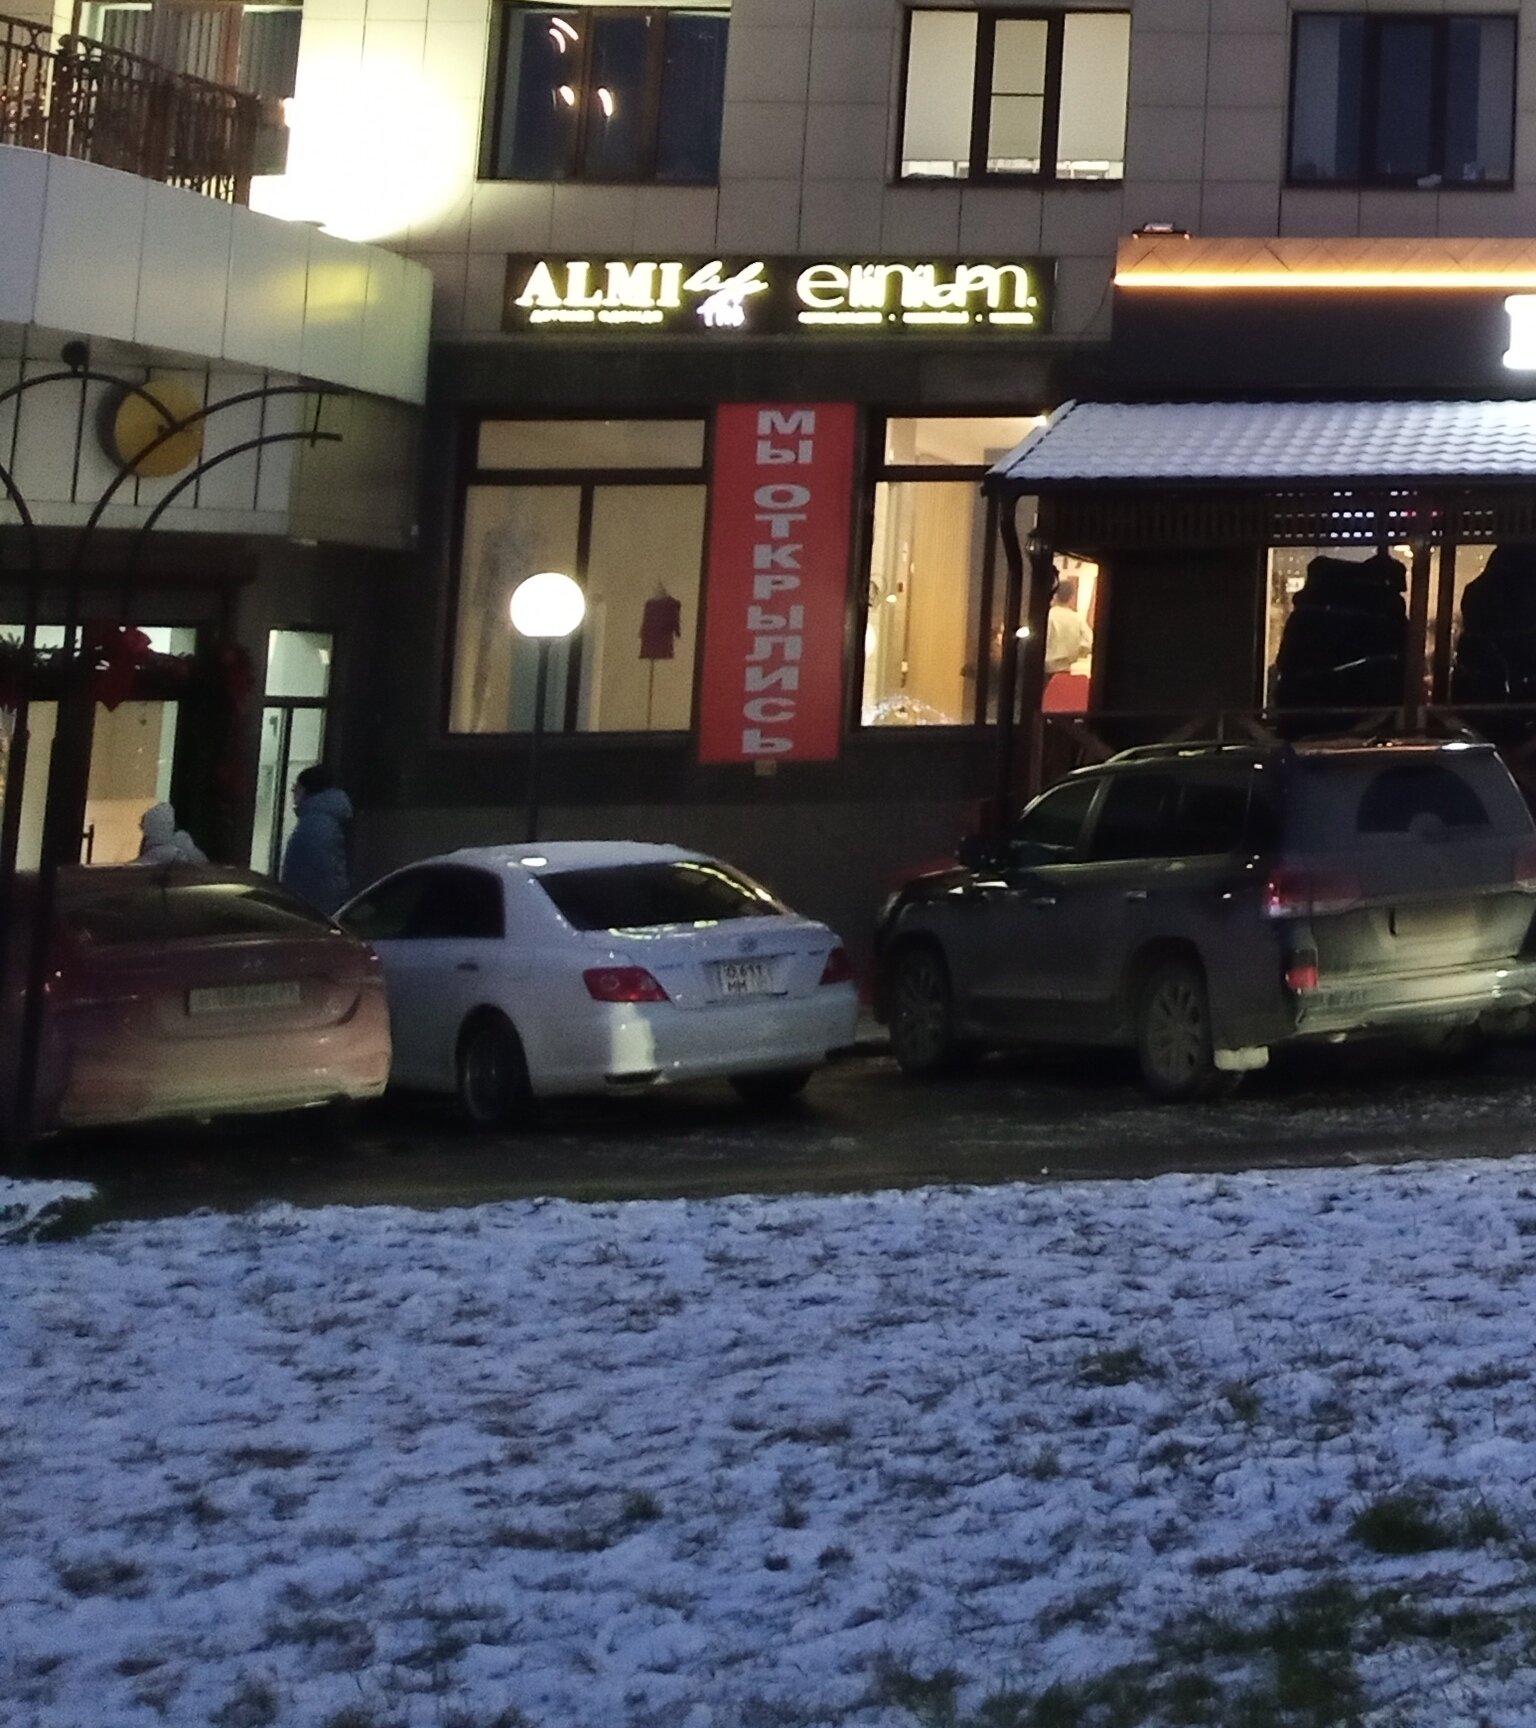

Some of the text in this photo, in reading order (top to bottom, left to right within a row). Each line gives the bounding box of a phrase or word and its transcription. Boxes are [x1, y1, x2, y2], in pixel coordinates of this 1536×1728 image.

[514, 260, 684, 308] ALMI
[756, 410, 816, 464] МЫ
[742, 483, 811, 754] ОТКРЫЛИСЬ
